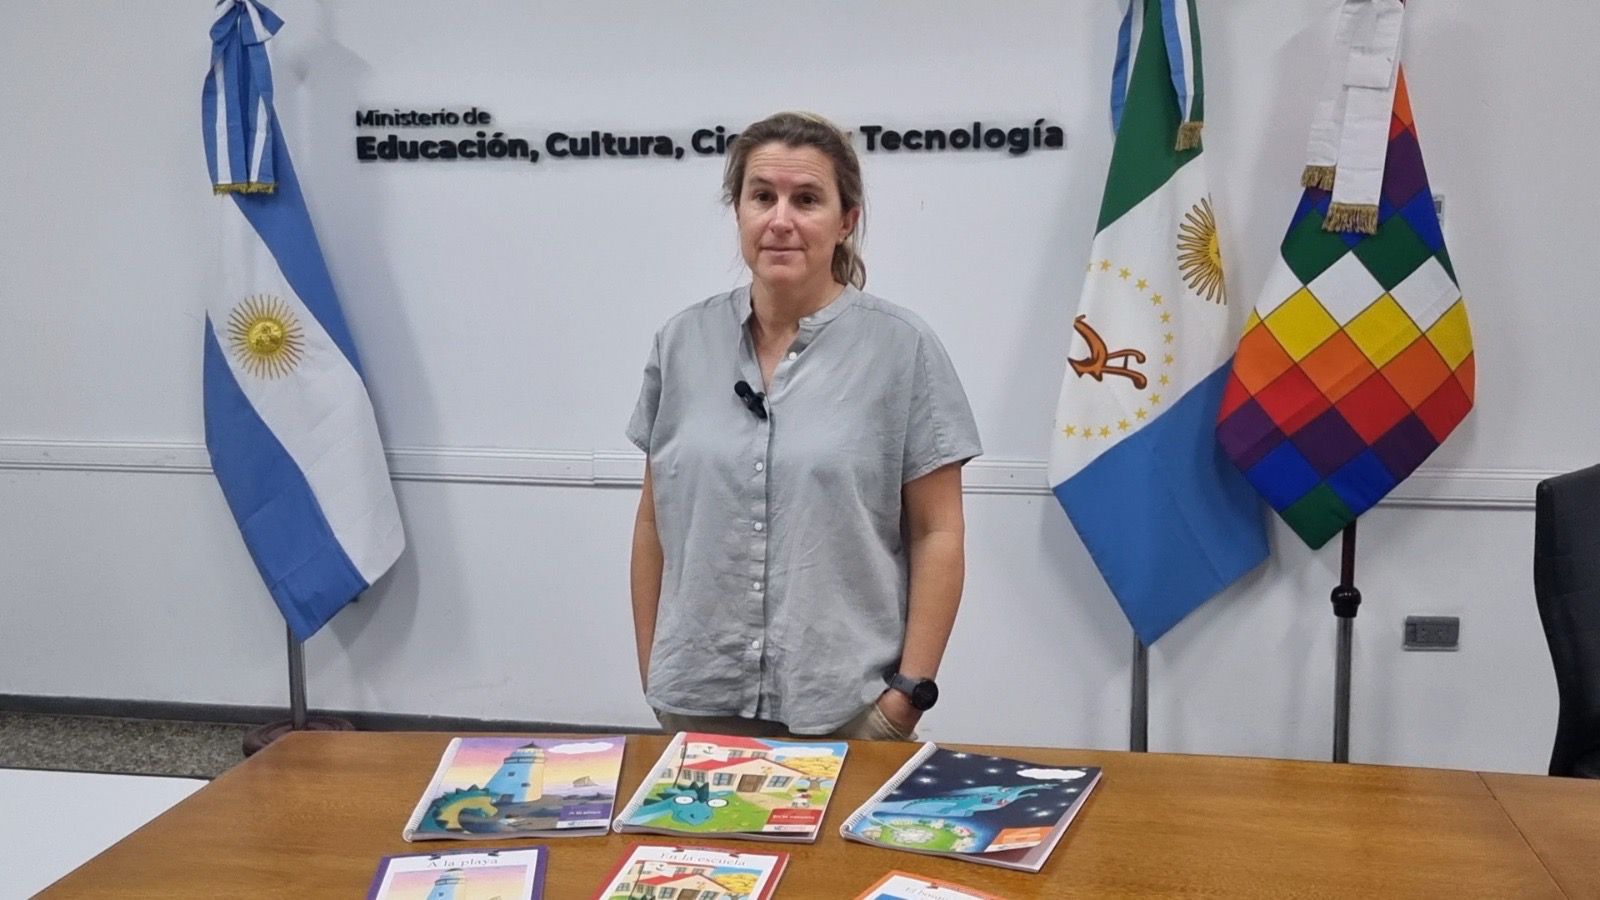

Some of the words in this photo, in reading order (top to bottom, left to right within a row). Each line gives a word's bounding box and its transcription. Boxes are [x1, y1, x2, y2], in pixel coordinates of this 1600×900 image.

[355, 108, 459, 127] Ministerio
[462, 107, 491, 125] de
[355, 131, 539, 163] Educación,
[545, 130, 684, 160] Cultura,
[860, 118, 1063, 154] Tecnología
